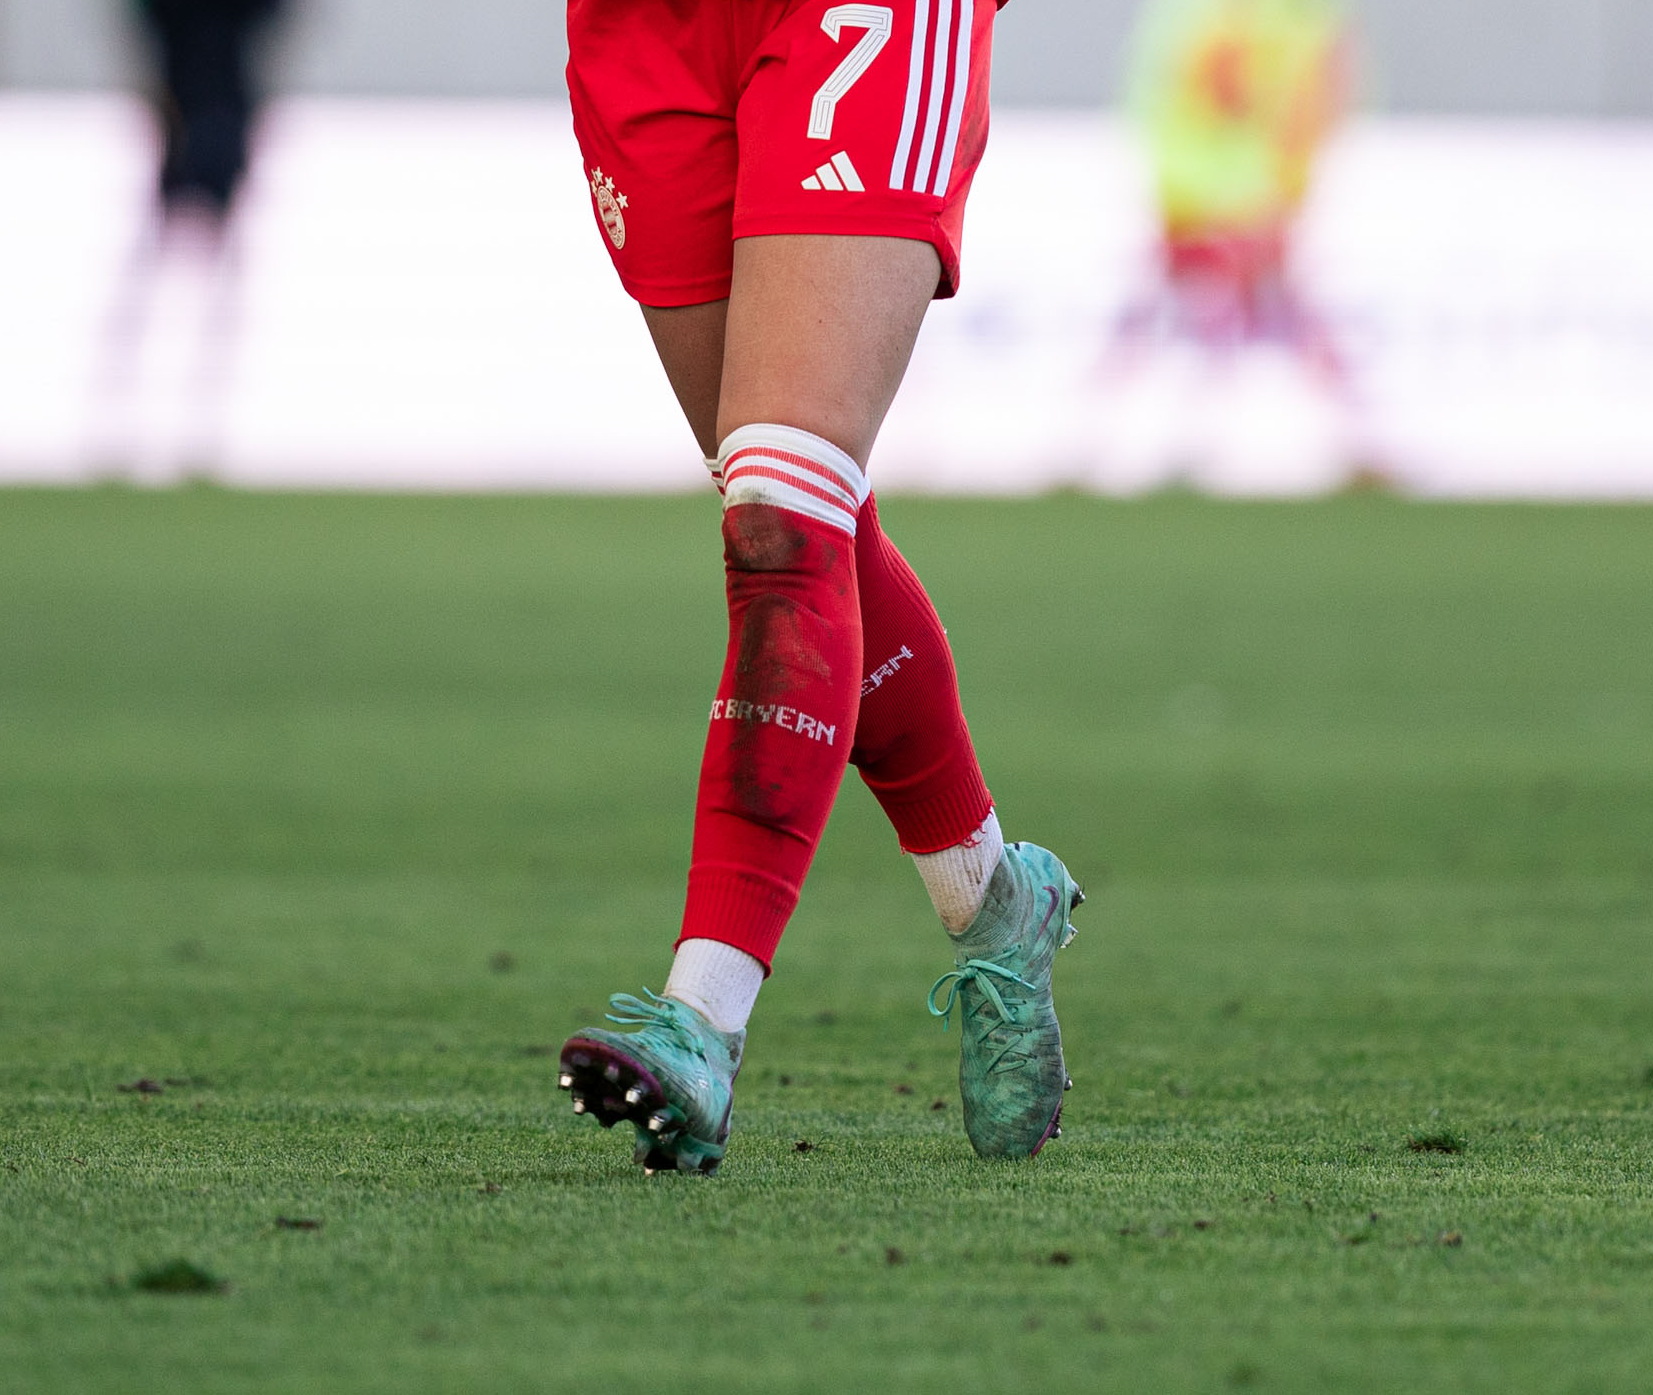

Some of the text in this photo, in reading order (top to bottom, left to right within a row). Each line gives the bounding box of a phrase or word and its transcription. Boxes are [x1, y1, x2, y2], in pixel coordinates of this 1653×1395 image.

[807, 3, 894, 140] 7
[859, 644, 914, 696] ERN
[725, 698, 837, 746] BAYERN
